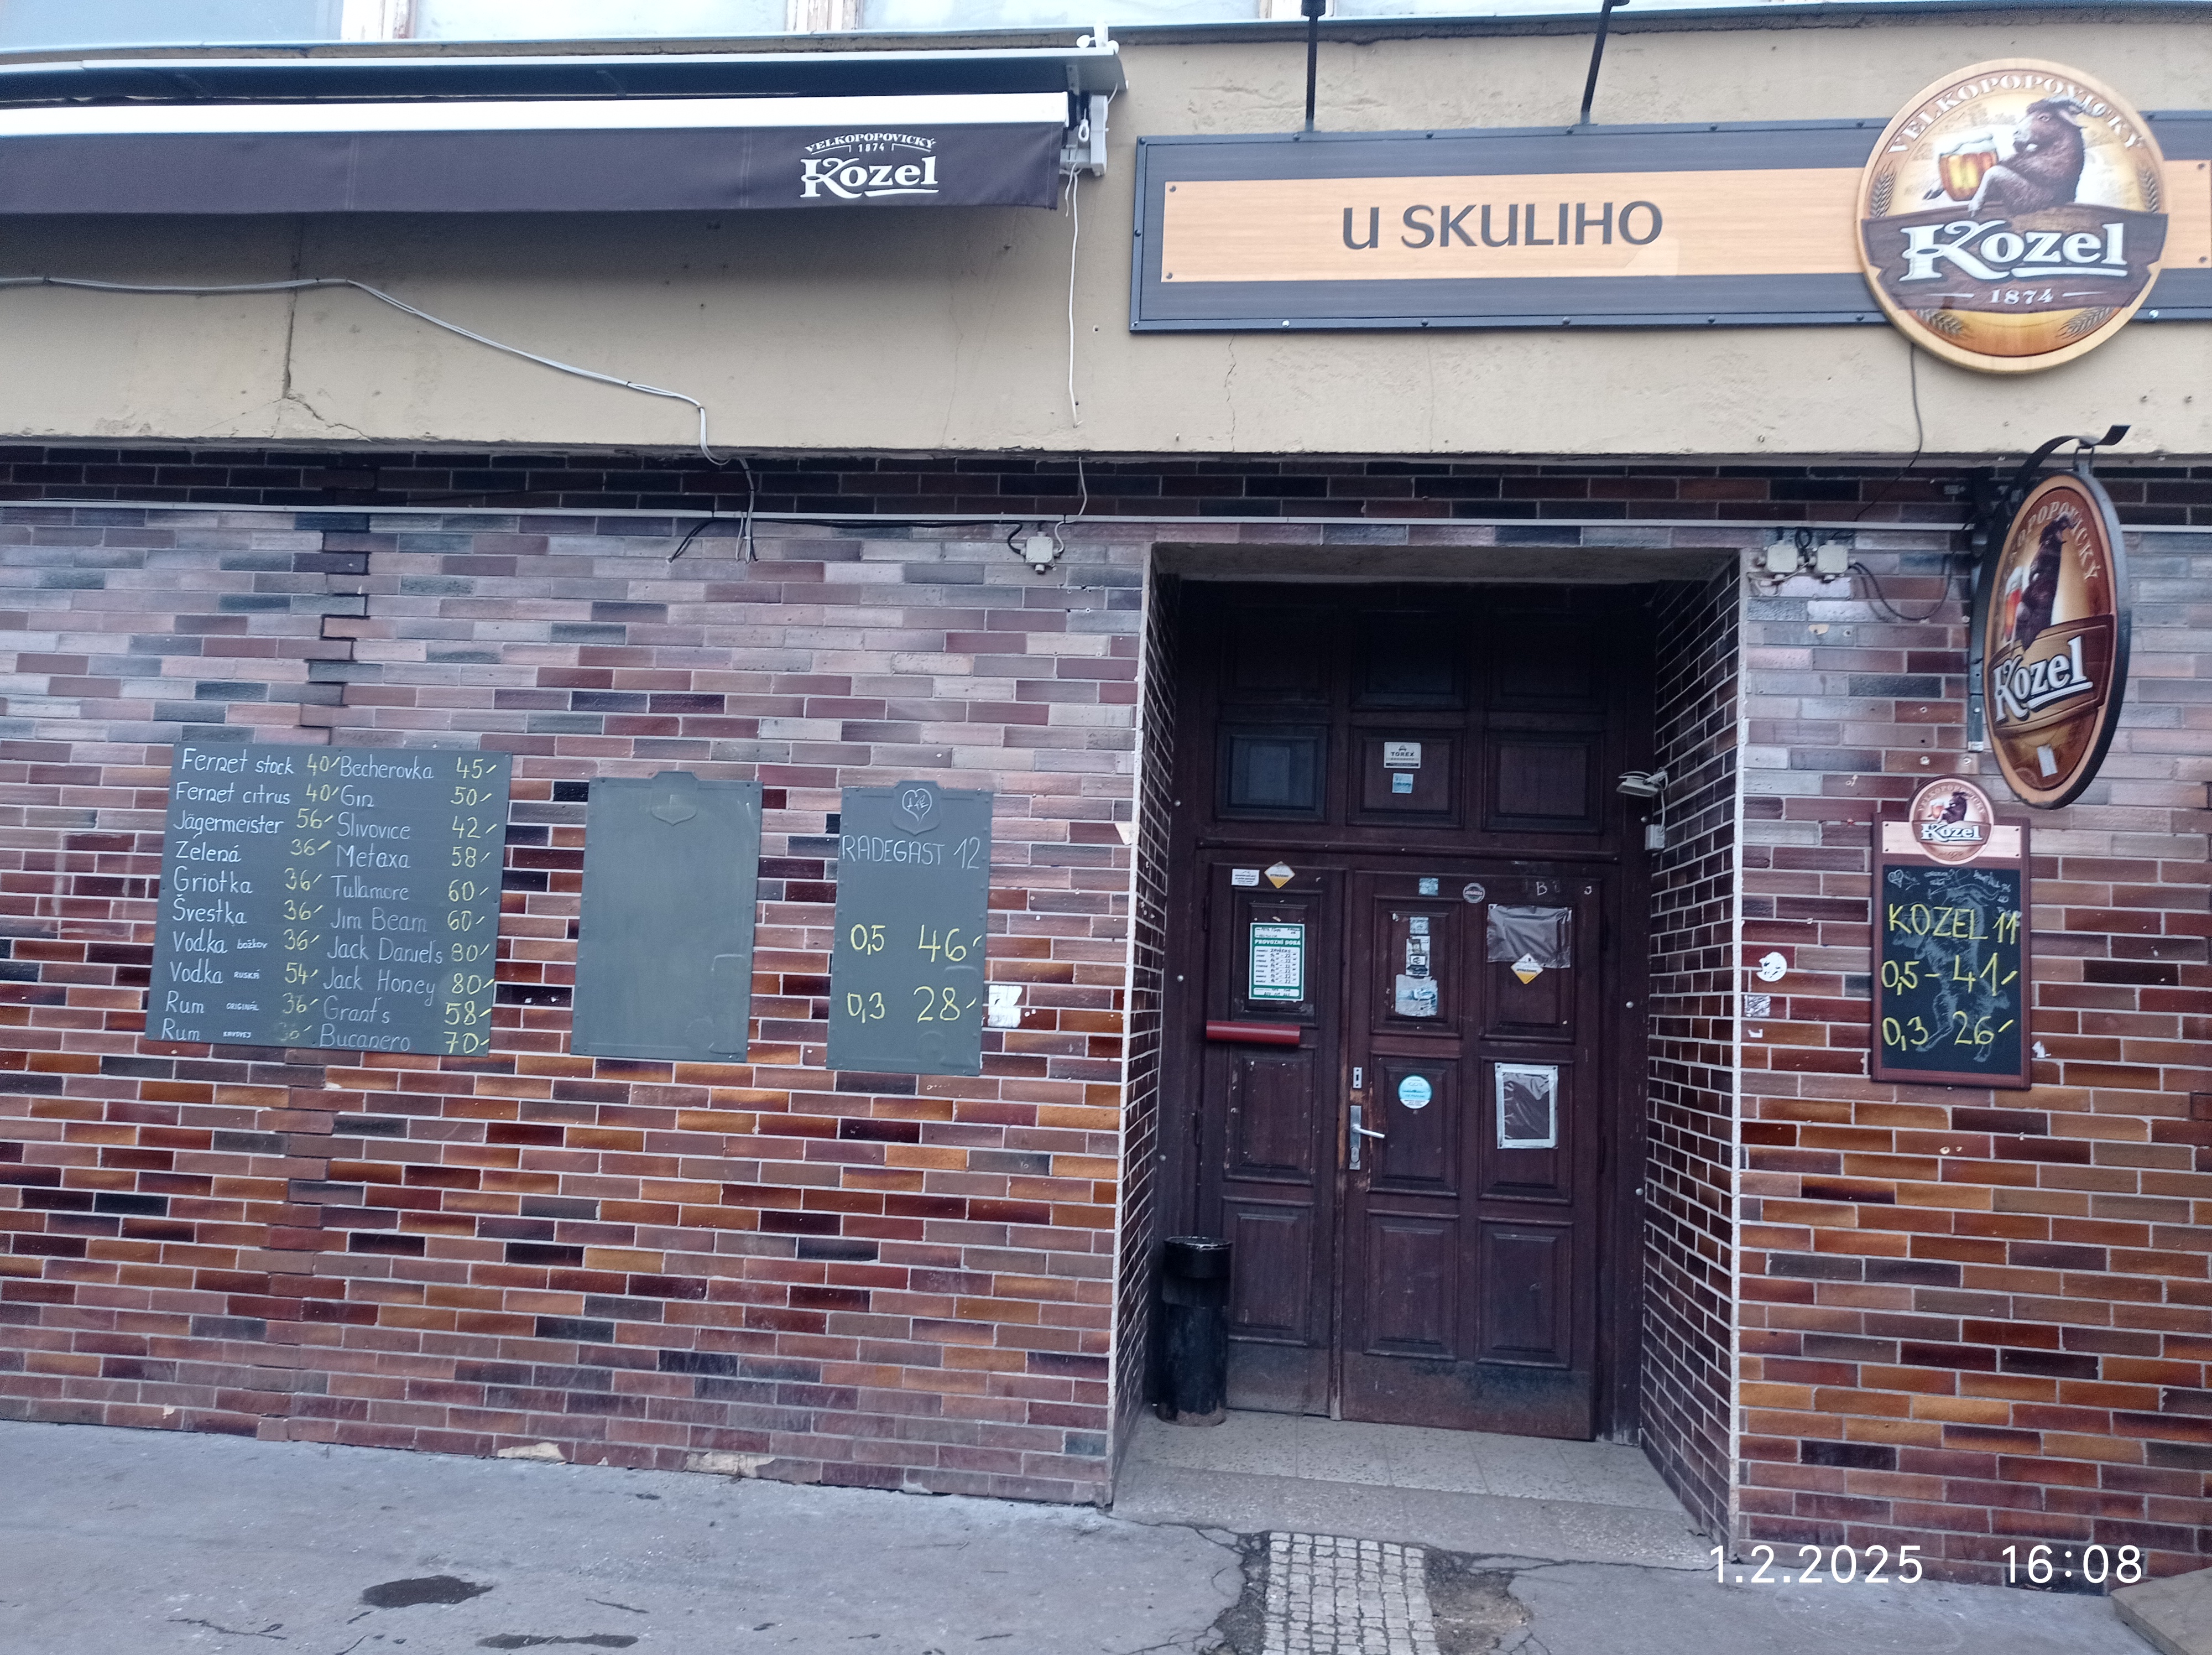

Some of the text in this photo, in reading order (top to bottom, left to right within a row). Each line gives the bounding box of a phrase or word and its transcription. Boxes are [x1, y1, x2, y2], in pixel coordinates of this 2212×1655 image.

[804, 132, 937, 152] VELKOPOPOVICKÝ
[858, 143, 885, 152] 1874
[800, 155, 939, 199] Kozel
[1401, 200, 1663, 249] SKULIHO
[1898, 220, 2128, 281] Kozel
[1991, 288, 2054, 304] 1874
[1992, 636, 2090, 722] Kozel
[181, 748, 248, 773] Fernet
[254, 754, 294, 775] stock
[340, 754, 434, 779] Becherovka
[176, 782, 234, 803] Fernet
[242, 784, 290, 804] citrus
[341, 784, 374, 808] Gin
[173, 810, 284, 839] Jägermeister
[336, 811, 411, 840] Slivovice
[1921, 823, 1983, 842] Kozel
[175, 841, 242, 862] Zelená
[336, 843, 411, 868] Metaxa
[842, 835, 980, 870] RADEGAST 12
[173, 866, 253, 893] Griotka
[331, 875, 409, 901] Tullamore
[172, 894, 247, 925] Švestka
[330, 908, 362, 929] Jim
[372, 907, 427, 932] Beam
[1888, 903, 2017, 945] KOZEL 11
[173, 928, 228, 954] Vodka
[326, 935, 370, 960] Jack
[850, 923, 886, 955] 0,5
[169, 958, 223, 984] Vodka
[1881, 960, 1920, 996] 0,5
[322, 965, 363, 991] Jack
[377, 969, 435, 1007] Honey
[165, 990, 205, 1014] Rum
[847, 991, 886, 1023] 0,3
[161, 1018, 201, 1041] Rum
[319, 1023, 410, 1052] Bucanero
[1882, 1016, 1929, 1051] 0,3
